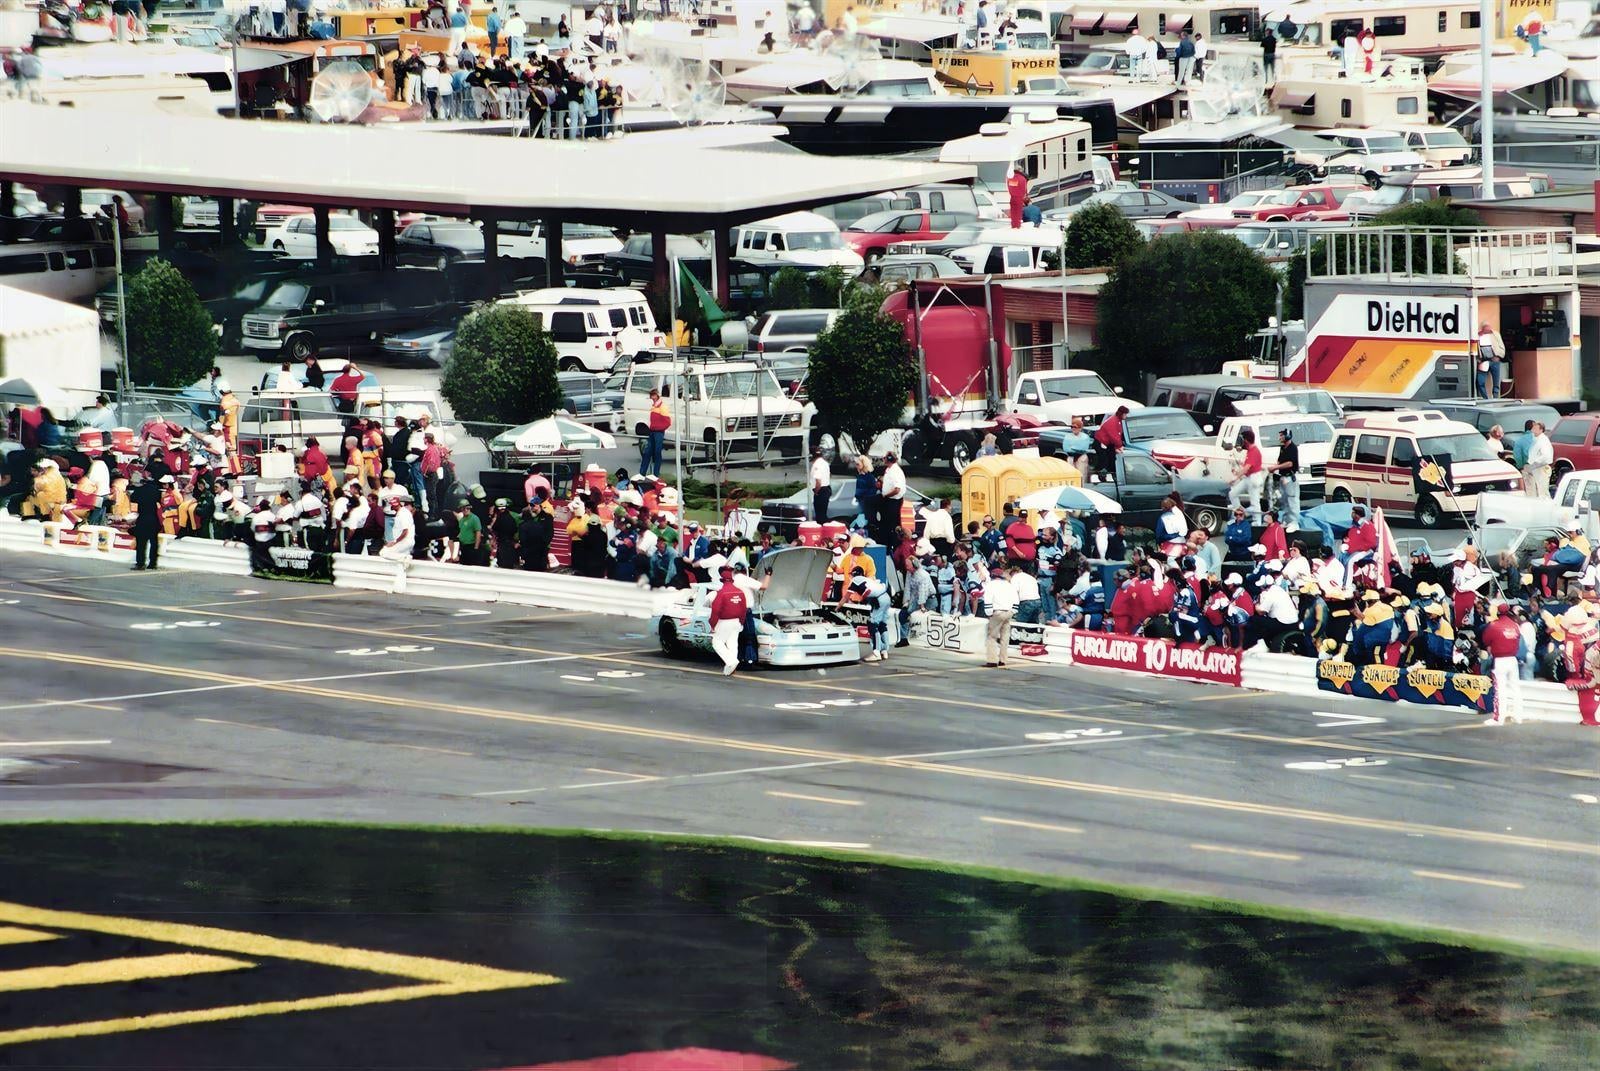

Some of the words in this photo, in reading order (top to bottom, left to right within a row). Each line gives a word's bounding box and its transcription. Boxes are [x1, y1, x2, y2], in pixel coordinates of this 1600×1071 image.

[1011, 59, 1055, 69] RYDER
[926, 614, 961, 649] 52
[1074, 635, 1138, 663] PUROLATOR
[1143, 640, 1167, 671] 10
[1170, 648, 1237, 676] PUROLATOR
[1321, 661, 1354, 679] SUNOCO
